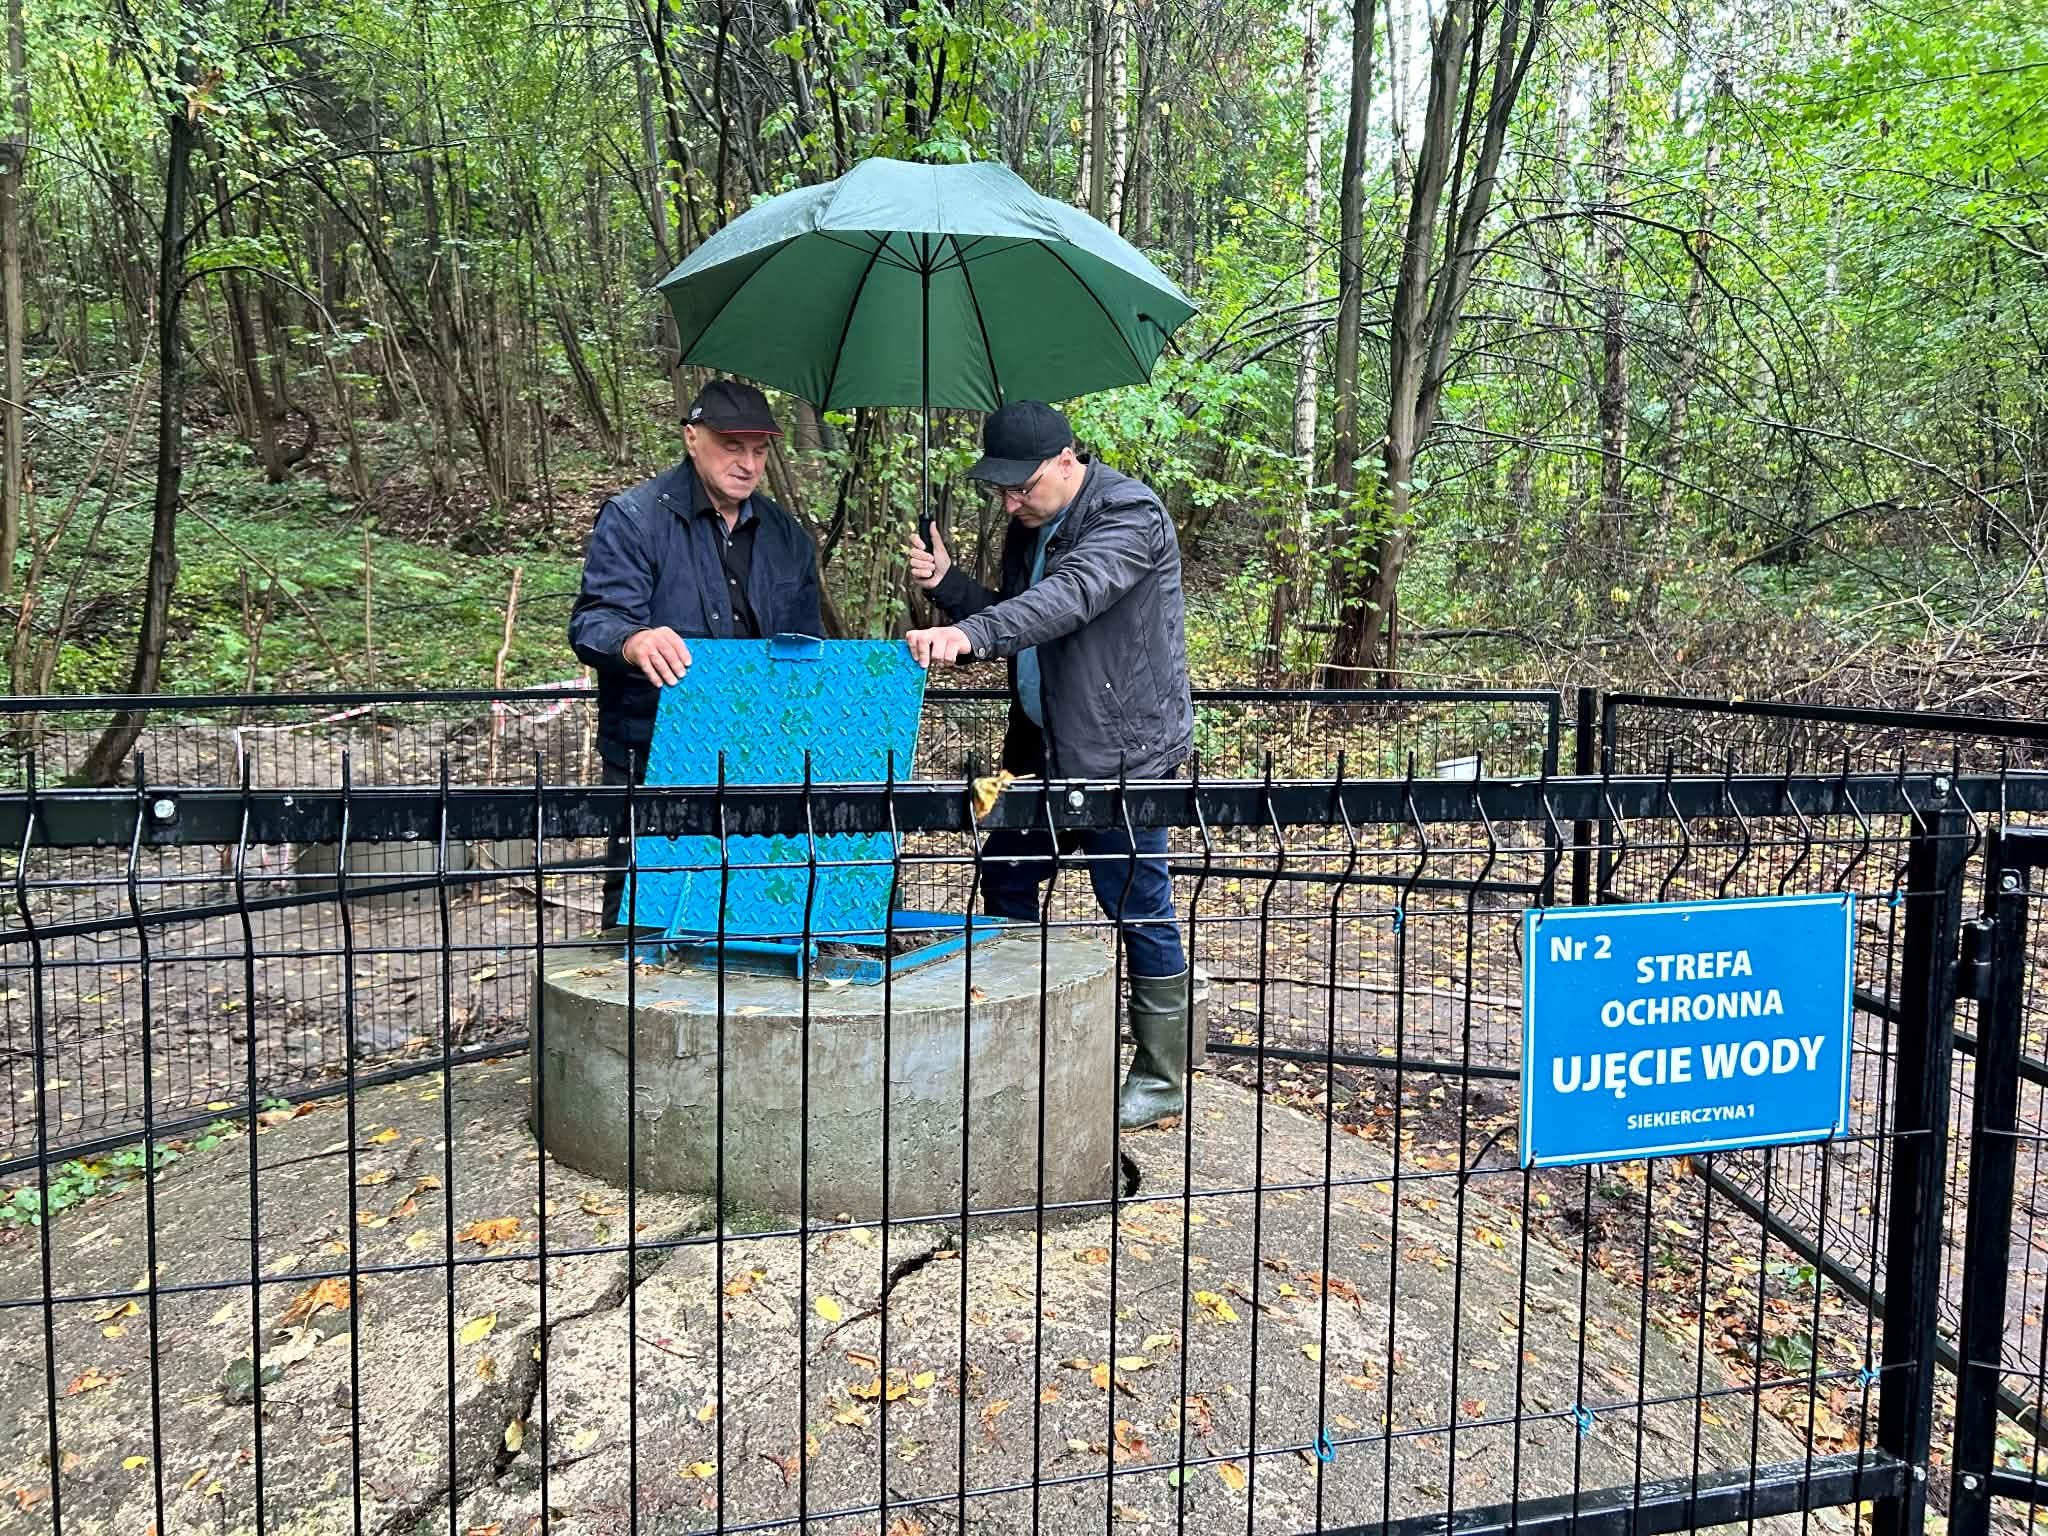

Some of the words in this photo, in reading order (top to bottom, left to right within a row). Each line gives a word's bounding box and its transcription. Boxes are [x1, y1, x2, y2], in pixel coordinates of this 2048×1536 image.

[1551, 936, 1588, 962] Nr
[1594, 935, 1612, 959] 2
[1636, 950, 1753, 984] STREFA
[1601, 989, 1783, 1028] OCHRONNA
[1552, 1046, 1692, 1099] UJĘCIE
[1701, 1035, 1825, 1080] WODY
